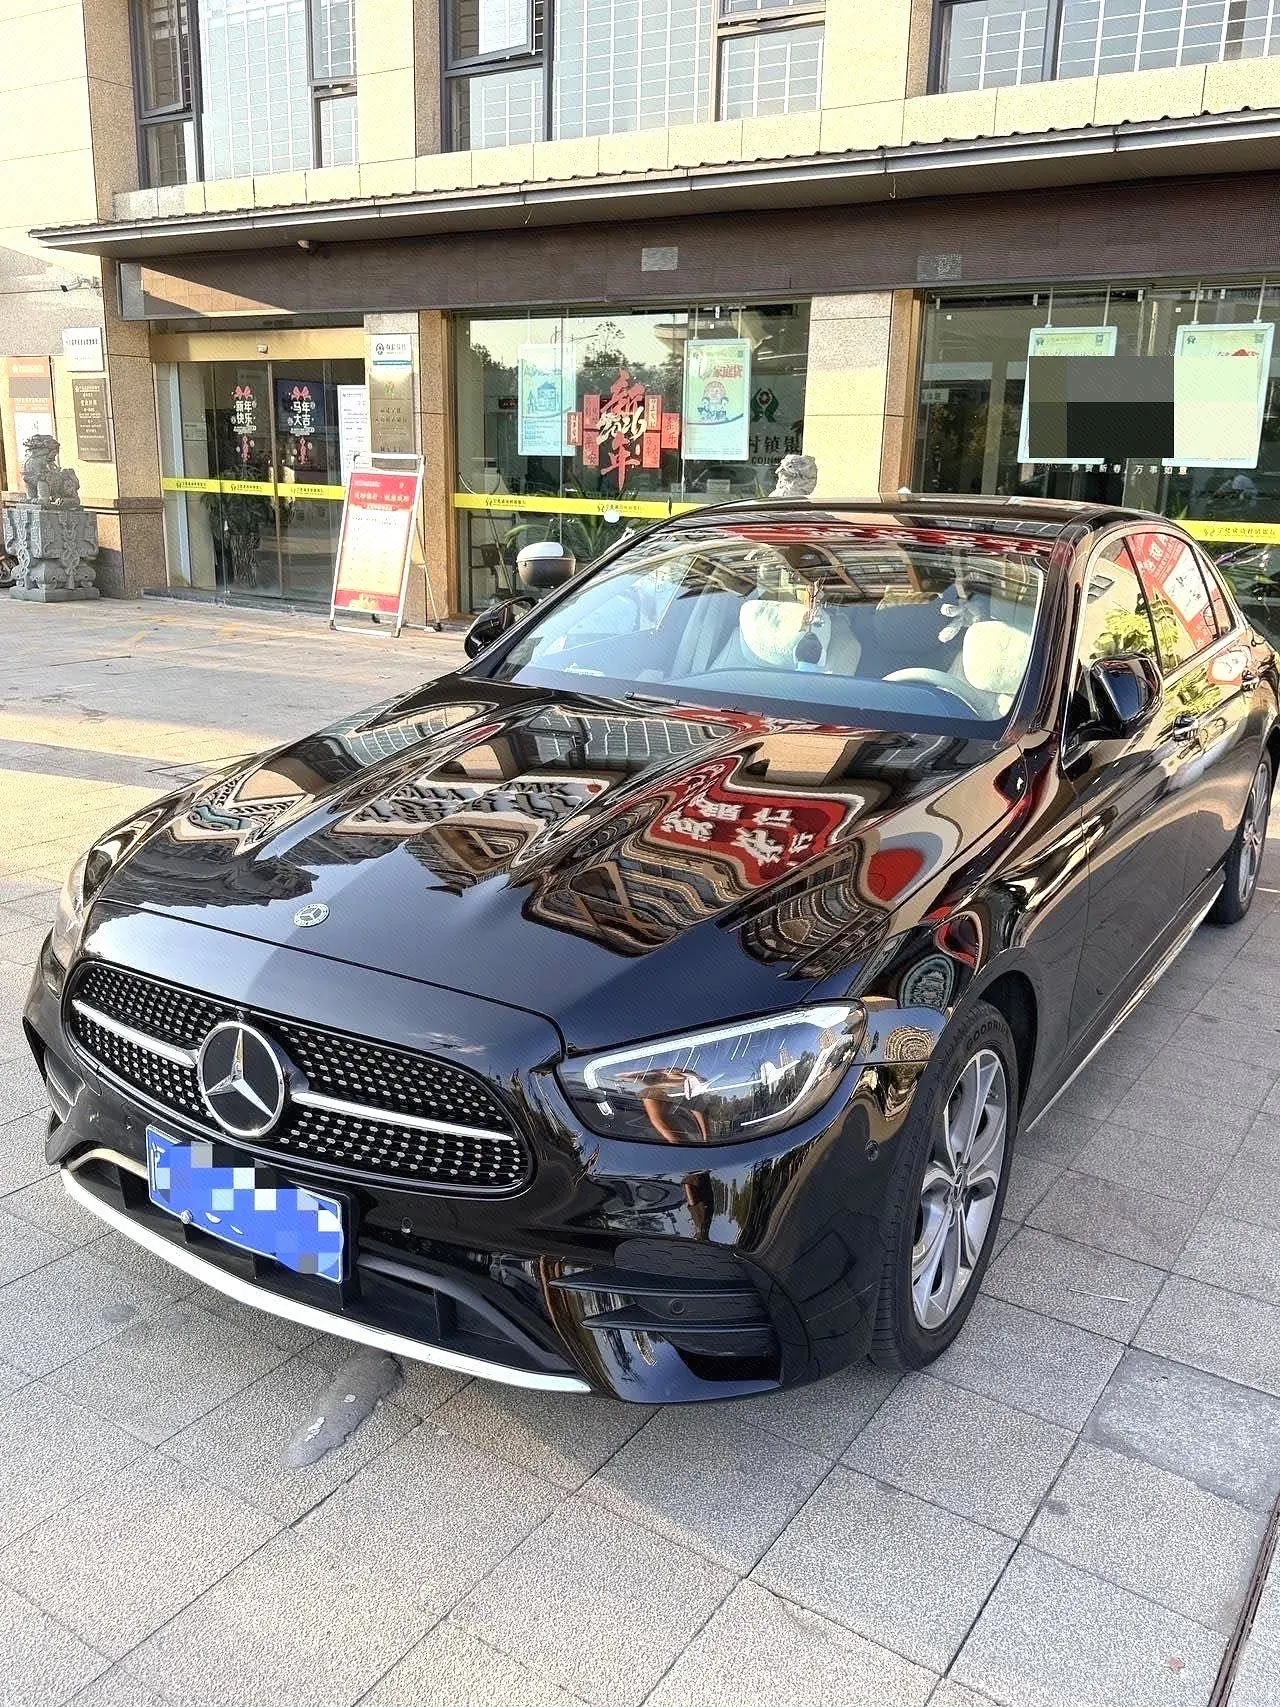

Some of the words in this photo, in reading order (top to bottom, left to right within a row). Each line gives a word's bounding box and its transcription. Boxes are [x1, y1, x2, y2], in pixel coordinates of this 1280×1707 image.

[235, 400, 253, 413] 新年
[293, 401, 311, 414] 马年
[236, 413, 253, 426] 快乐
[293, 414, 311, 426] 大吉
